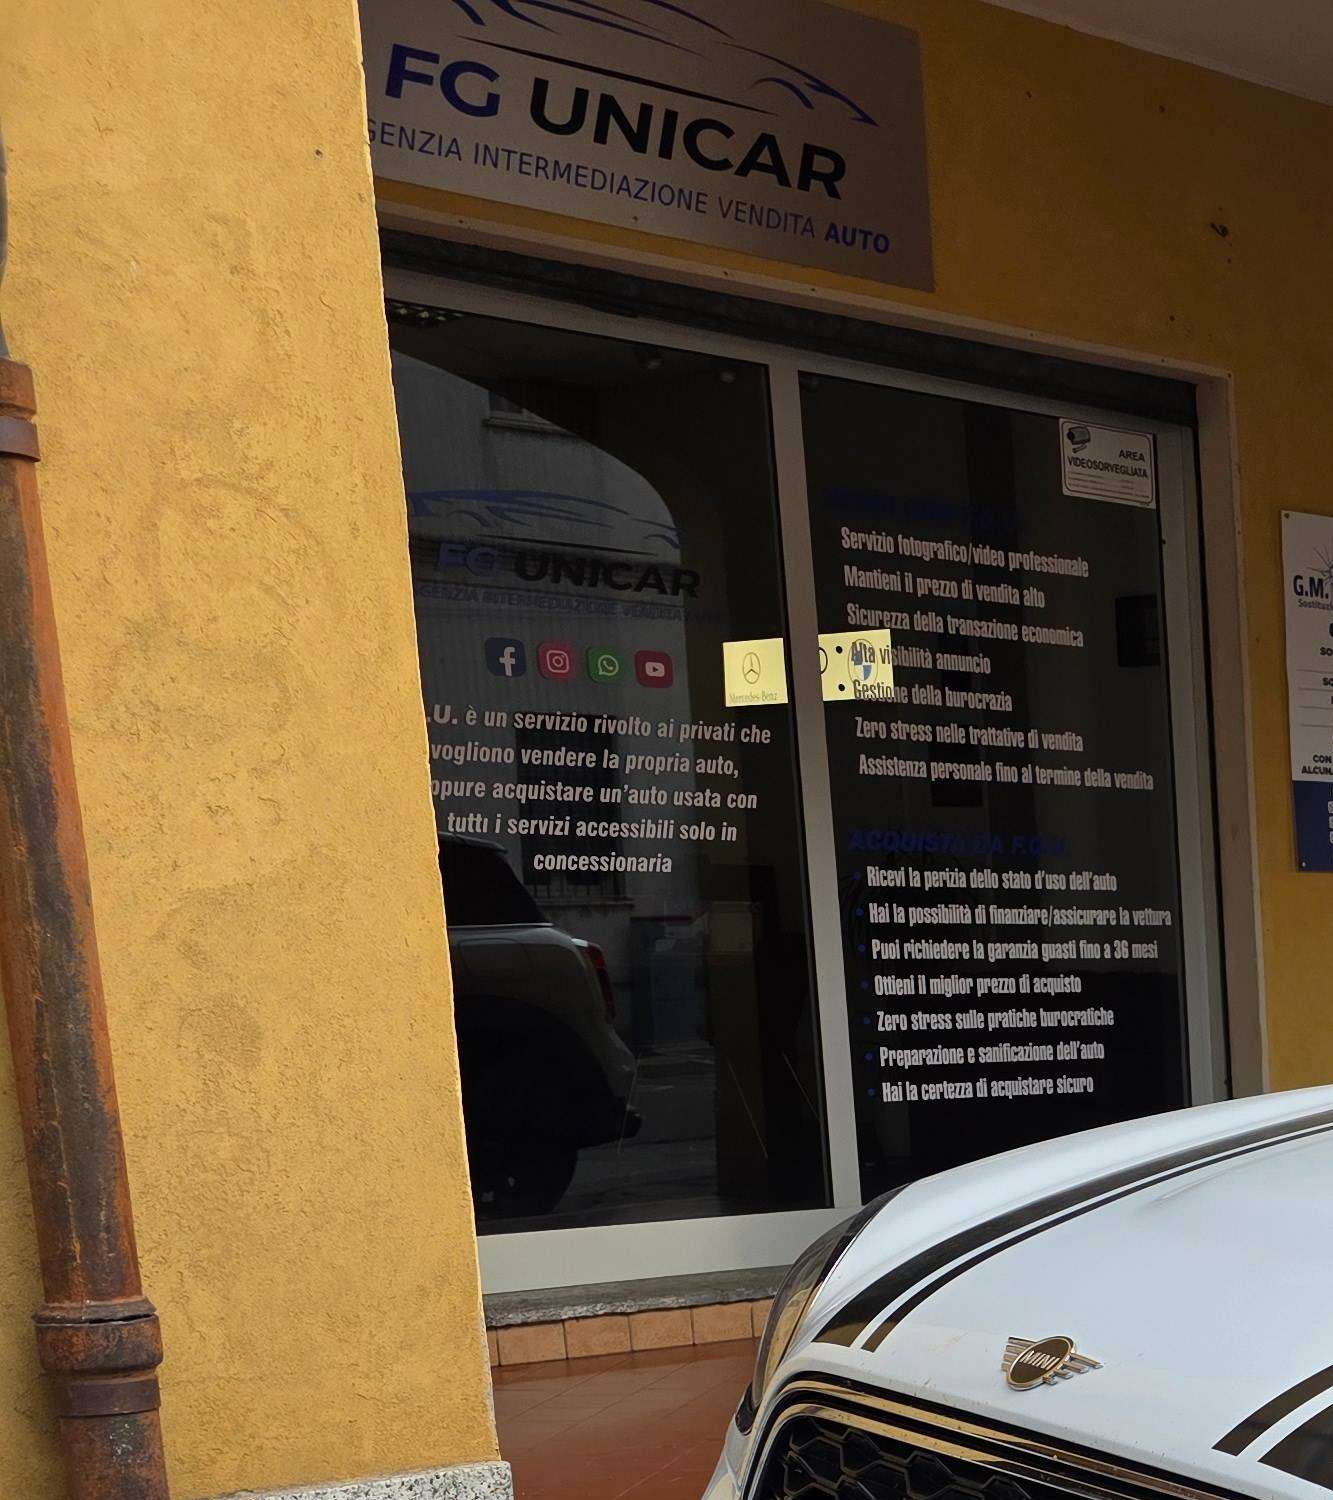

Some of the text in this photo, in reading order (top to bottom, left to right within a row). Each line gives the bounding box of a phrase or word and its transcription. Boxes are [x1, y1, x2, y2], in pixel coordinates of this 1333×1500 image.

[384, 42, 847, 200] FG UNICAR
[473, 143, 709, 214] INTERMEDIAZIONE
[718, 196, 816, 239] VENDITA
[824, 222, 891, 255] AUTO
[1067, 456, 1148, 478] VIDEOSORVEGLIATA
[1119, 449, 1146, 463] AREA
[840, 526, 894, 554] Servizio
[1008, 550, 1089, 578] professionale
[439, 542, 701, 599] FG UNICAR
[843, 564, 1045, 608] Mantieni il prezzo di vendita alto
[1293, 574, 1329, 600] G.M.
[846, 602, 1084, 647] Sicurezza della transazione economica
[850, 641, 990, 674] Alta visibilità annuncio
[852, 679, 1012, 711] Gestione della burocrazia
[466, 705, 476, 725] è
[484, 711, 506, 727] un
[514, 710, 587, 732] servizio
[591, 711, 650, 736] rivolto
[658, 718, 673, 737] ai
[680, 720, 735, 742] privati
[740, 724, 770, 743] che
[854, 716, 1083, 752] Zero stress nelle trattative di vendita
[431, 741, 738, 779] vogliono vendere la propria auto,
[859, 753, 1154, 790] Assistenza personale fino al termine della vendita
[492, 781, 593, 803] acquistare
[600, 785, 667, 804] un'auto
[673, 789, 720, 807] usata
[727, 793, 757, 808] con
[446, 812, 737, 841] tutti i servizi accessibili solo in
[533, 851, 672, 872] concessionaria
[866, 865, 1117, 891] Ricevi la perizia dello stato d'uso dell'auto
[868, 902, 1171, 927] Hai la possibilità di finanziare/assicurare la vettura
[871, 938, 1158, 962] Puoi richiedere la garanzia guasti fino a 36 mesi
[874, 973, 1082, 998] Ottieni il miglior prezzo di acquisto
[876, 1006, 1114, 1032] Zero stress sulle pratiche burocratiche
[879, 1040, 1105, 1069] Preparazione e sanificazione dell'auto
[881, 1074, 1094, 1102] Hai la certezza di acquistare sicuro
[1019, 1349, 1061, 1371] MINI
